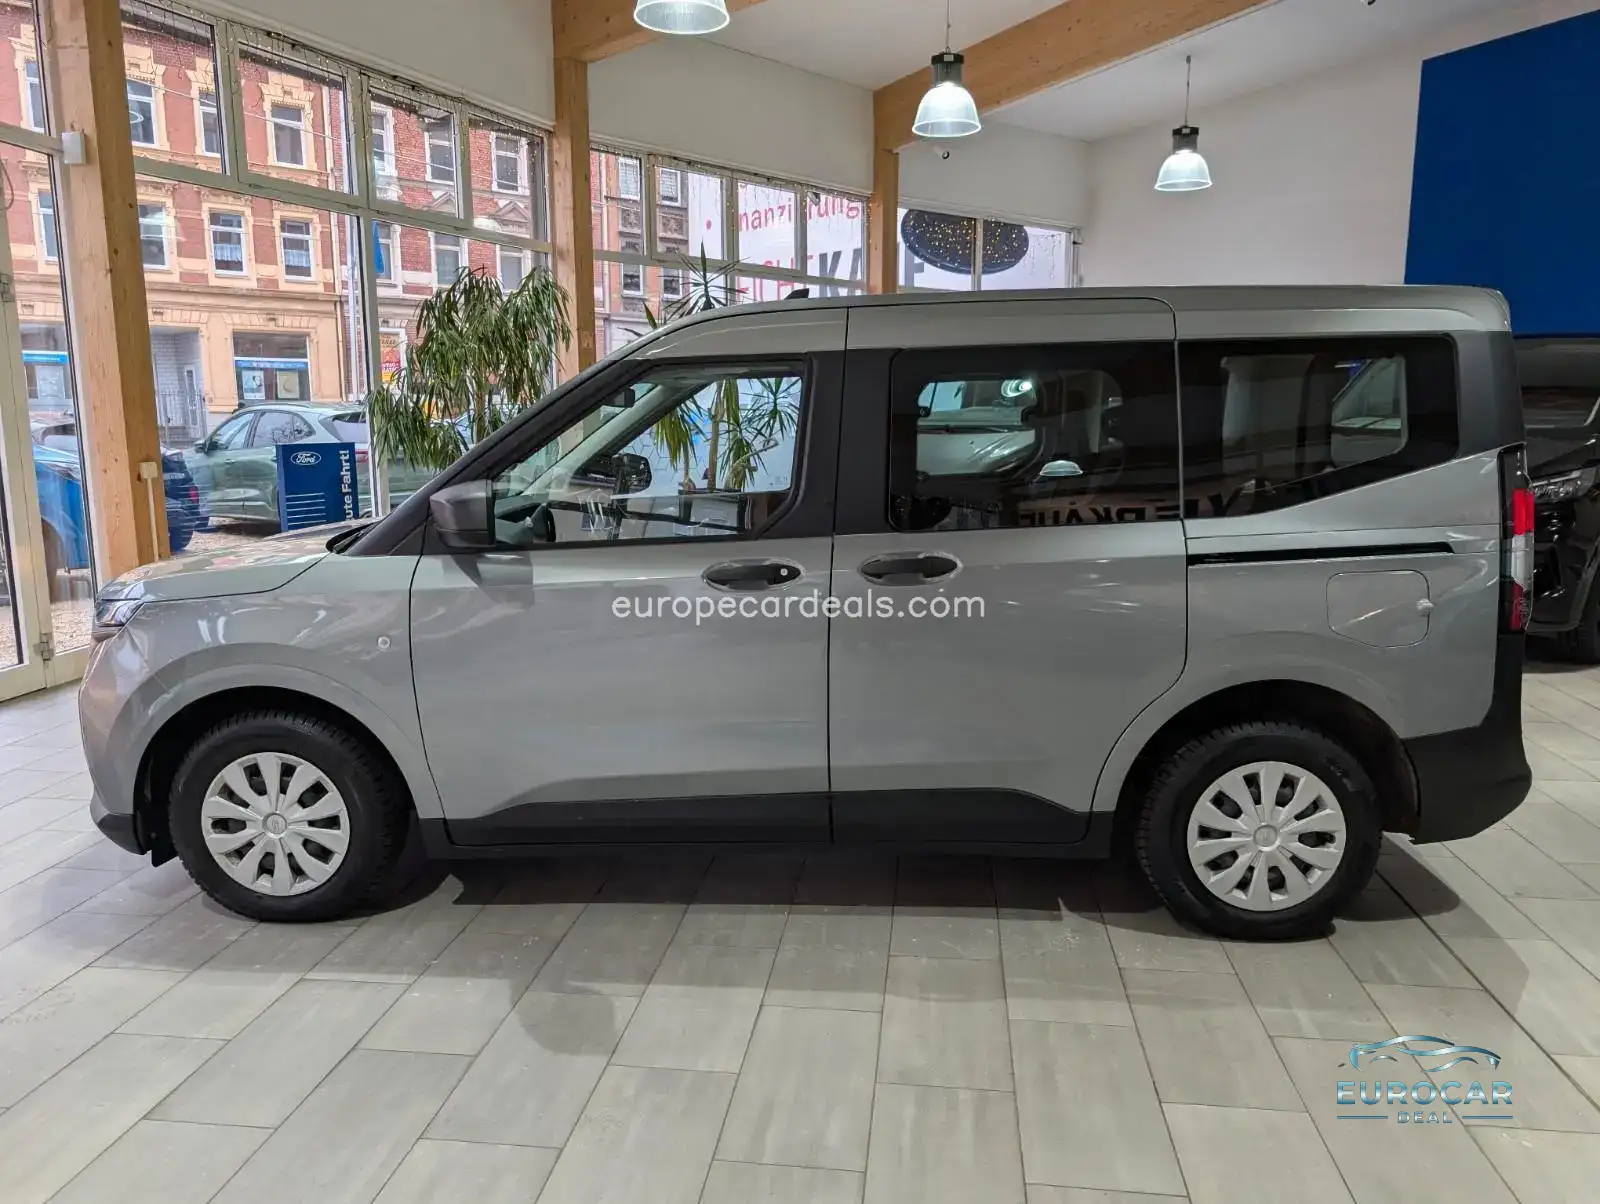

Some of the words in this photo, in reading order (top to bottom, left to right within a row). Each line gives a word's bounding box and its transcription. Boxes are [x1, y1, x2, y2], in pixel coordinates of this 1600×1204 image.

[295, 452, 317, 464] Ford
[339, 450, 352, 493] Fahrt!
[343, 495, 354, 520] ute
